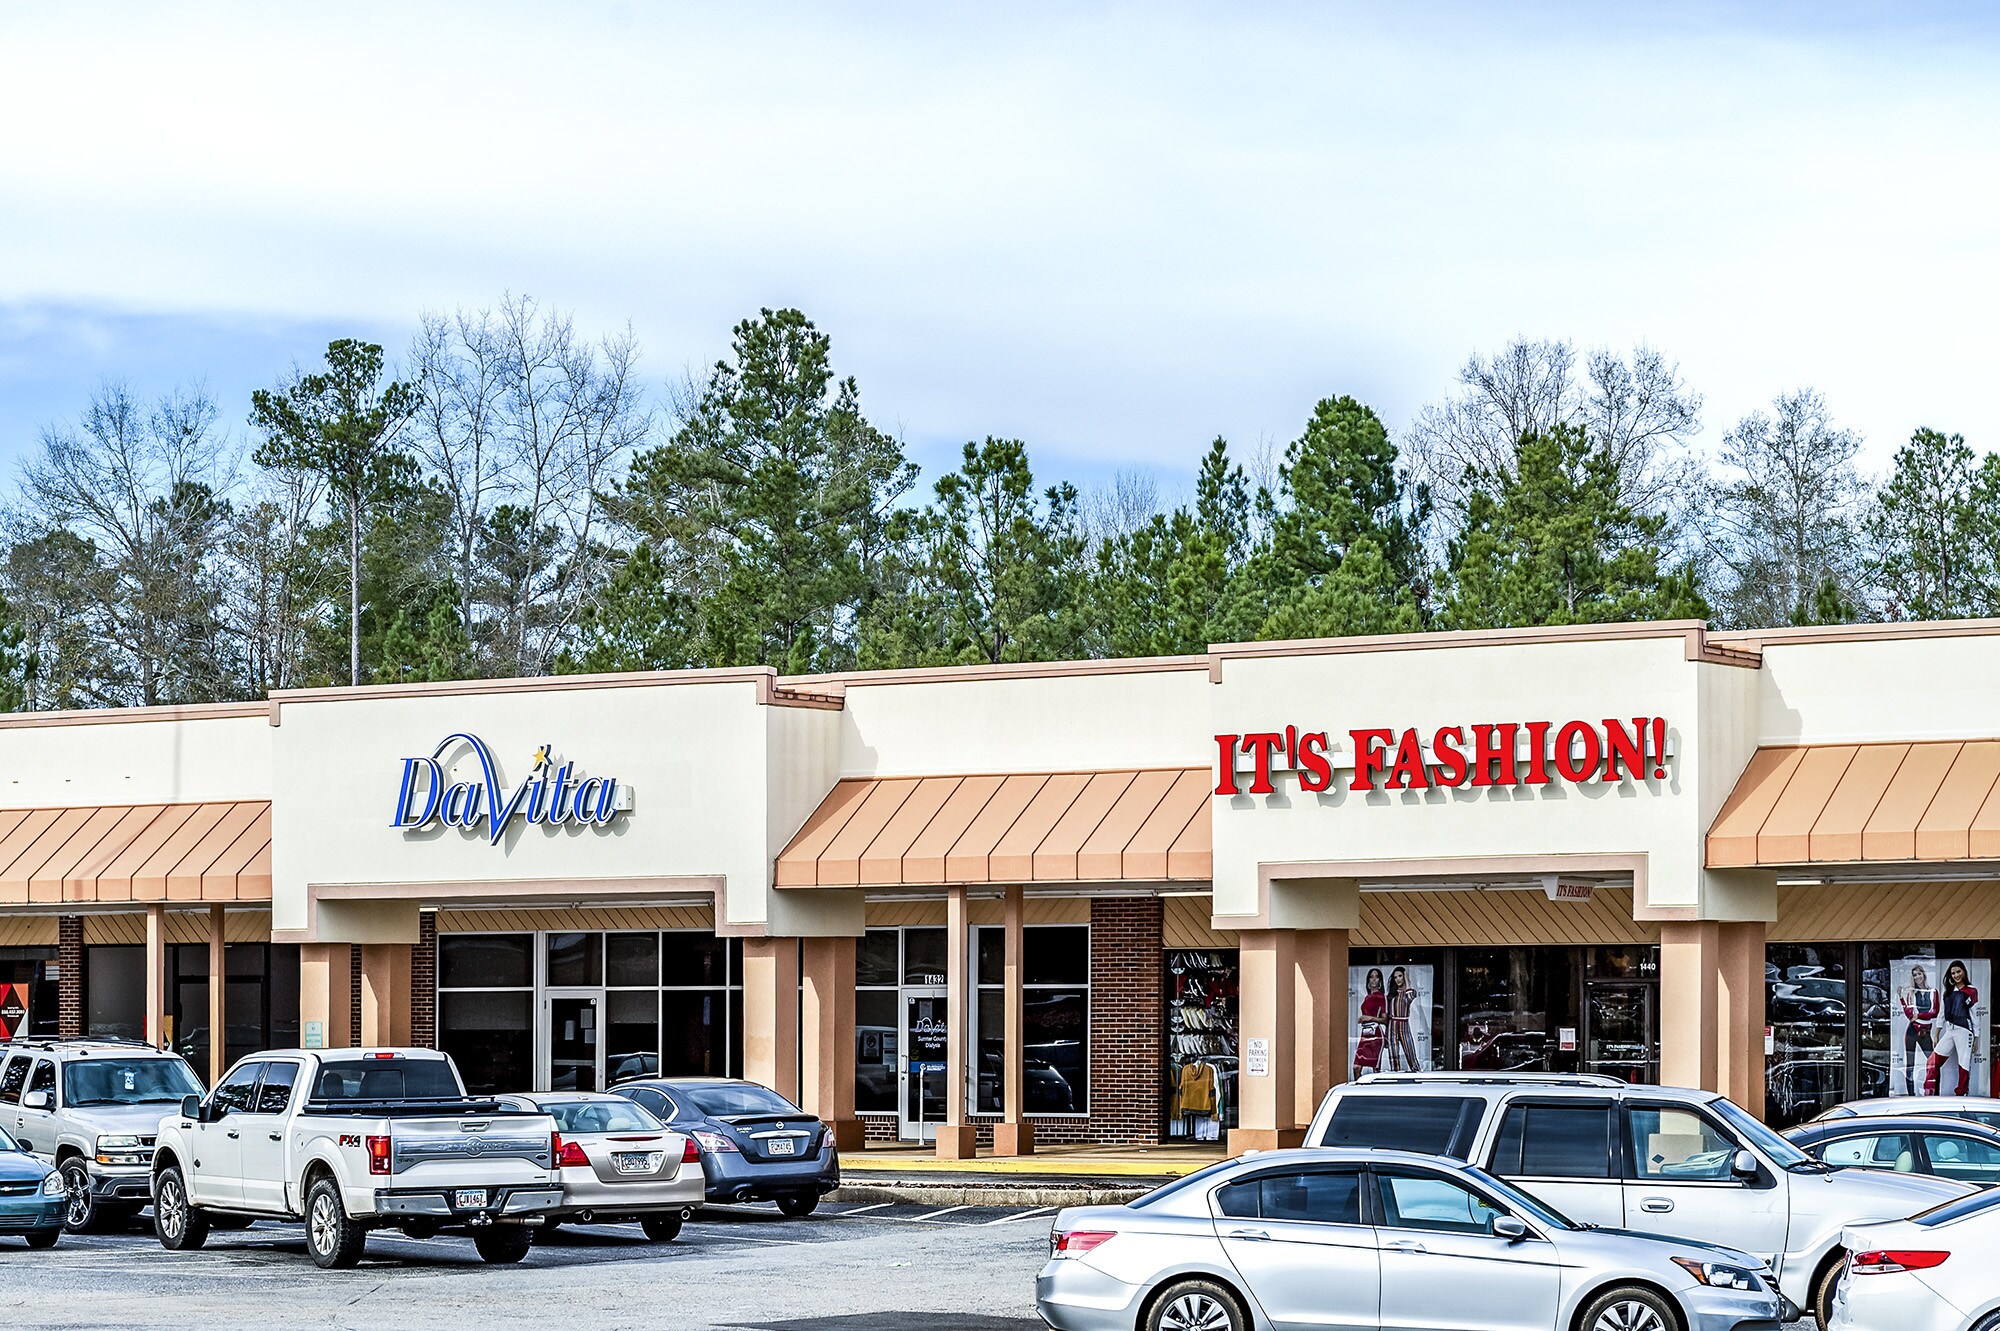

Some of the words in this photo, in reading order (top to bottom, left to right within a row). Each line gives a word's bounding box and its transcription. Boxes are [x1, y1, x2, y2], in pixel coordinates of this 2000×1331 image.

[1214, 724, 1335, 794] IT'S
[1349, 716, 1667, 791] FASHION!
[389, 733, 618, 847] DaVita
[1556, 884, 1567, 897] IT'S
[925, 975, 944, 985] 1432
[339, 1134, 361, 1146] FX4
